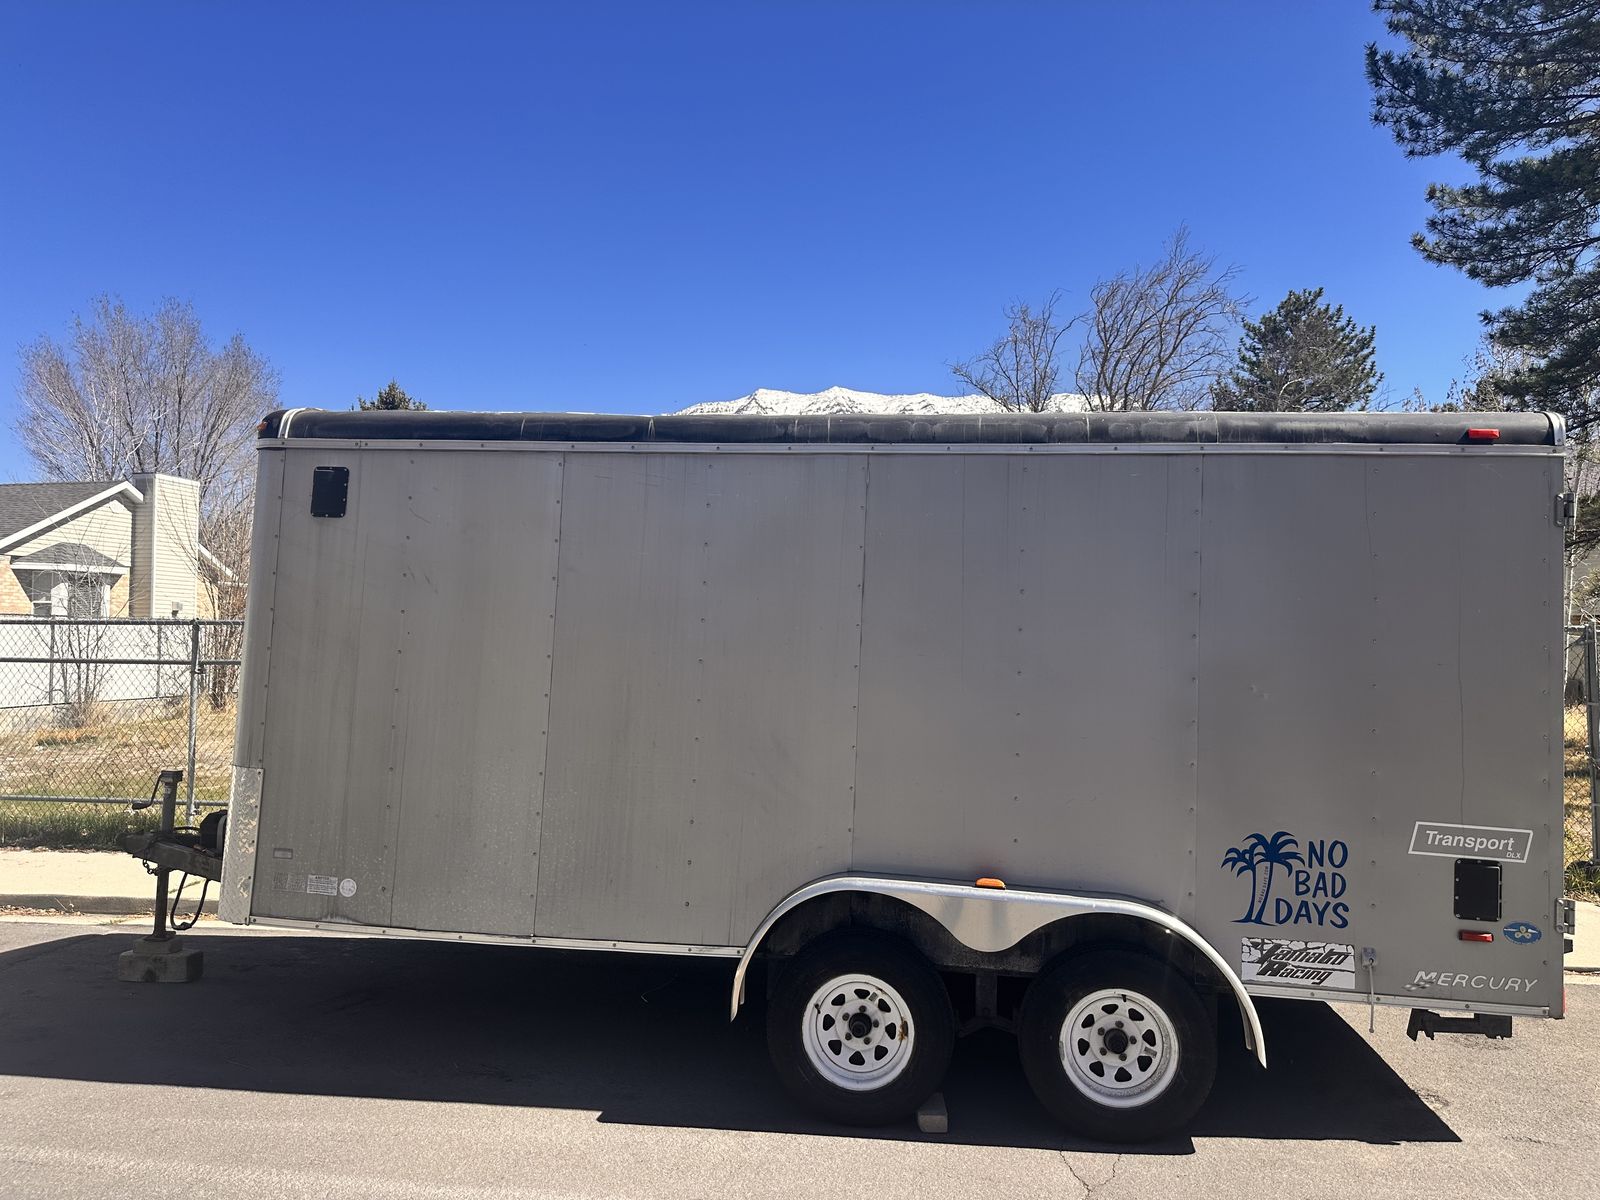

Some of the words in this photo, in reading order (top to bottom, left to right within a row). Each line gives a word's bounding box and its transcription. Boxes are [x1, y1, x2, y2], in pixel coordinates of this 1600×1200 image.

[1307, 839, 1349, 869] NO
[1425, 830, 1515, 852] Transport
[1506, 851, 1522, 860] DLX
[1294, 870, 1347, 898] BAD
[1274, 898, 1350, 929] DAYS
[1256, 960, 1333, 986] Racing
[1413, 970, 1538, 993] MERCURY
